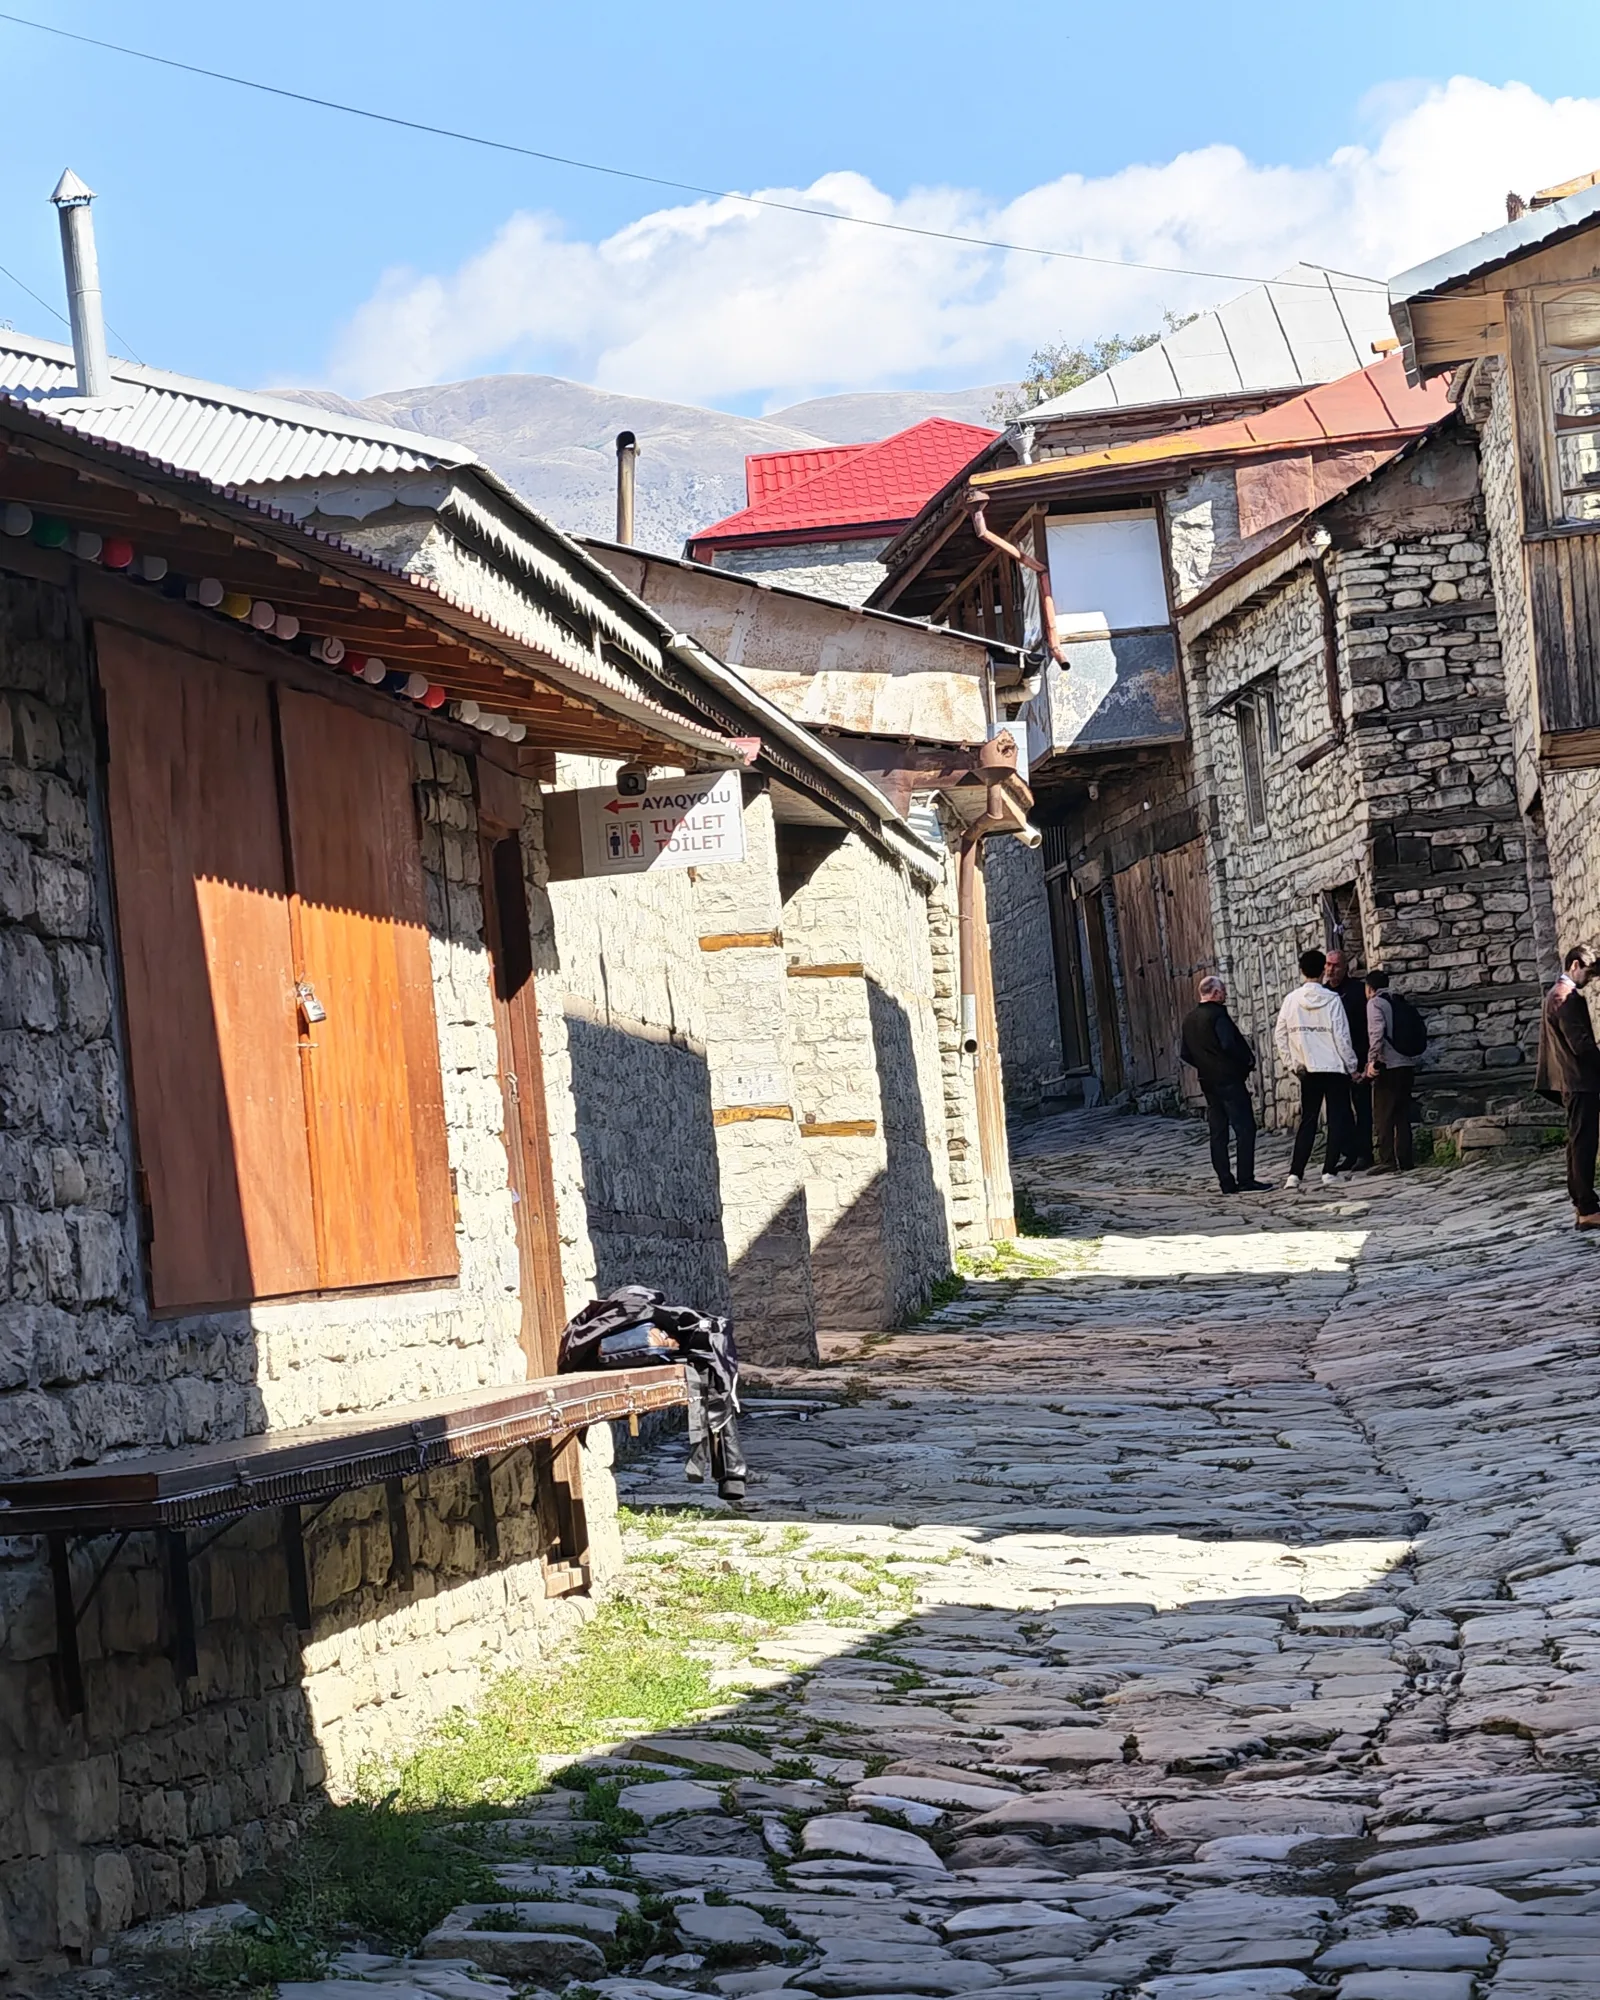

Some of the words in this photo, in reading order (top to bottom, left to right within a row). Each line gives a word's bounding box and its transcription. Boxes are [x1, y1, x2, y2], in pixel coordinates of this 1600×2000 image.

[641, 790, 731, 810] AYAQYOLU
[650, 814, 725, 834] TUALET
[654, 834, 725, 853] TOİLET
